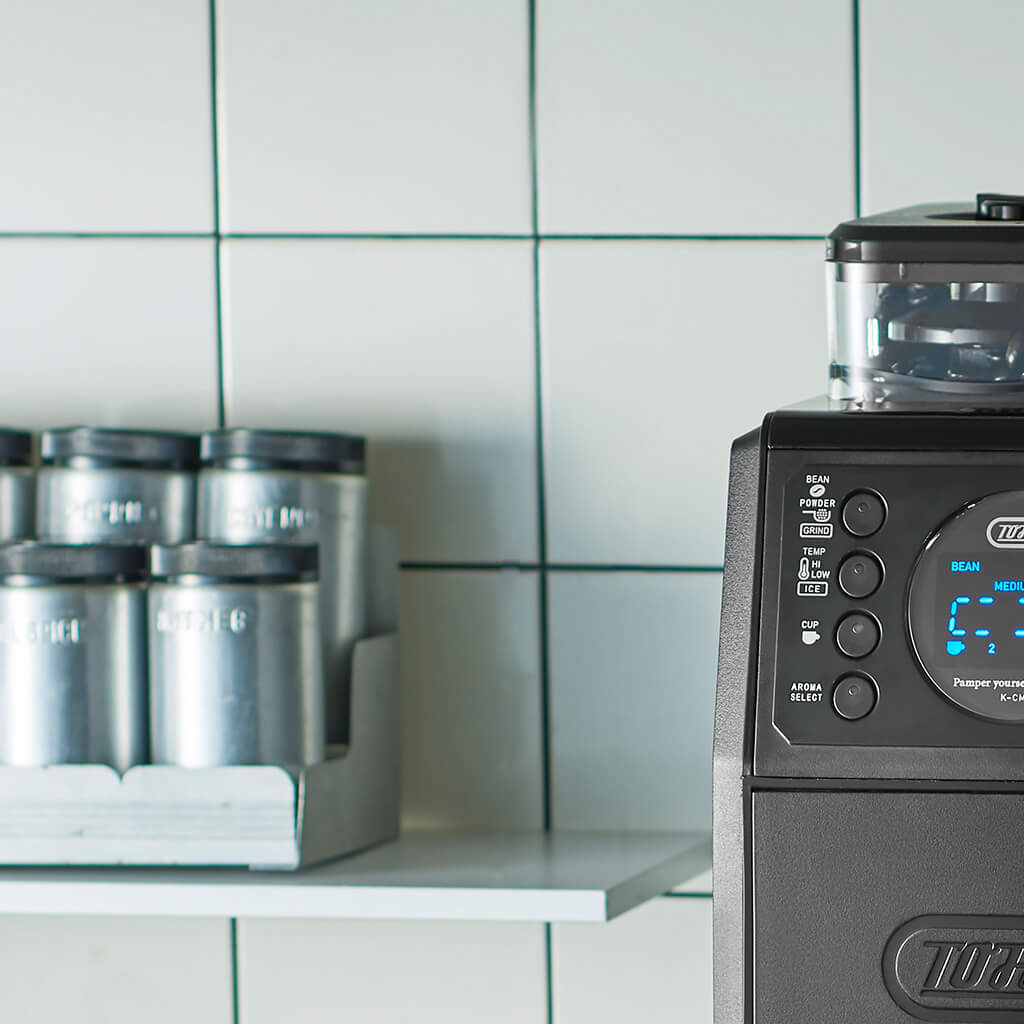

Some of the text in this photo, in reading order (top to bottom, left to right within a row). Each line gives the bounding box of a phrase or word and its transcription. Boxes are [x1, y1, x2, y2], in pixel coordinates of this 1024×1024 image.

[805, 474, 830, 484] BEAN
[799, 498, 836, 508] POWDER
[803, 526, 830, 536] GRIND
[802, 546, 826, 556] TEMP
[811, 560, 821, 569] HI
[951, 561, 981, 572] BEAN
[811, 570, 831, 579] LOW
[804, 584, 821, 594] ICE
[801, 620, 820, 629] CUP
[987, 642, 997, 655] 2
[790, 682, 822, 692] AROMA
[952, 677, 991, 689] Pamper
[790, 692, 823, 702] SELECT
